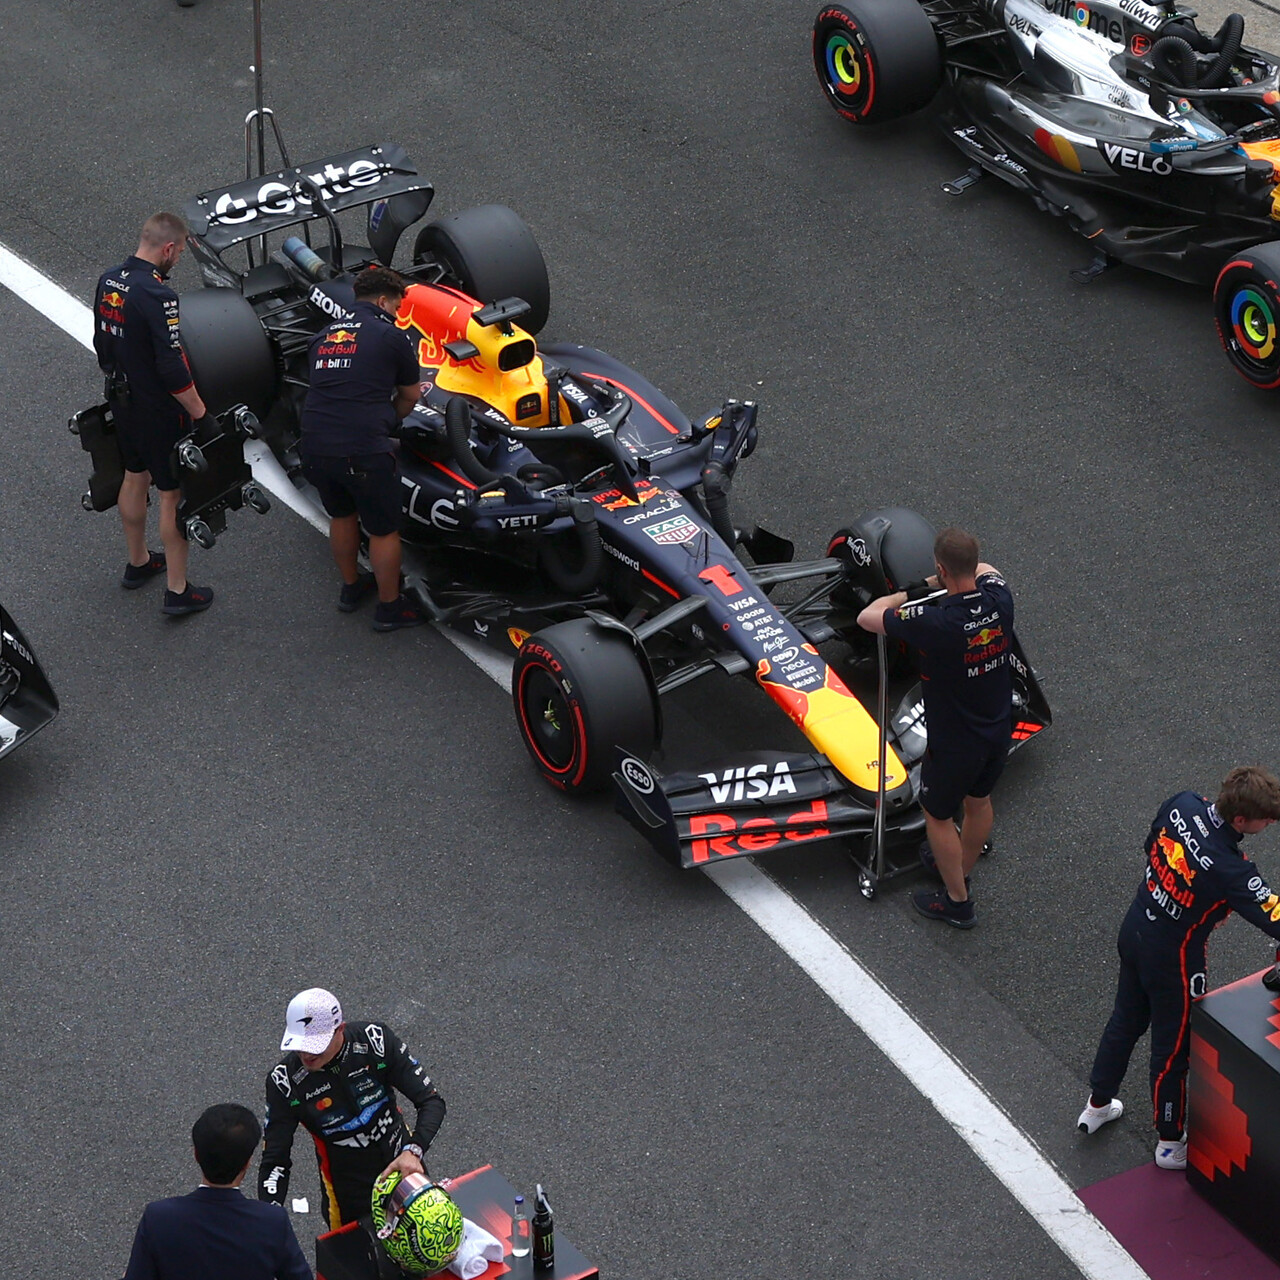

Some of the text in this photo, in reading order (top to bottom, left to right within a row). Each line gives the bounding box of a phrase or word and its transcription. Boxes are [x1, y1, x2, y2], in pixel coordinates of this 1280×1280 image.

[1009, 13, 1031, 38] DELL
[1005, 153, 1028, 175] KAUST
[1104, 142, 1173, 176] VELO
[105, 278, 130, 293] ORACLE
[310, 287, 356, 321] HON
[330, 322, 362, 331] ORACLE
[317, 343, 358, 356] Red Bull
[315, 359, 340, 370] Mobil
[497, 515, 538, 529] YETI
[623, 500, 683, 525] ORACLE
[649, 516, 688, 534] TAG
[654, 525, 699, 544] HEUER
[699, 564, 743, 597] 1
[727, 596, 758, 611] VISA
[754, 615, 774, 627] AT&T
[963, 611, 1000, 631] ORACLE
[752, 627, 785, 642] TRADE
[771, 649, 794, 663] CDW
[963, 637, 1009, 664] Red Bull
[785, 665, 817, 681] PIRELLI
[967, 658, 998, 678] Mobil
[791, 676, 816, 689] Mobil
[624, 764, 653, 789] Esso
[698, 761, 798, 803] VISA
[689, 801, 831, 863] Red
[1170, 808, 1214, 872] ORACLE
[1150, 841, 1196, 909] Red Bull
[305, 1082, 332, 1101] Android
